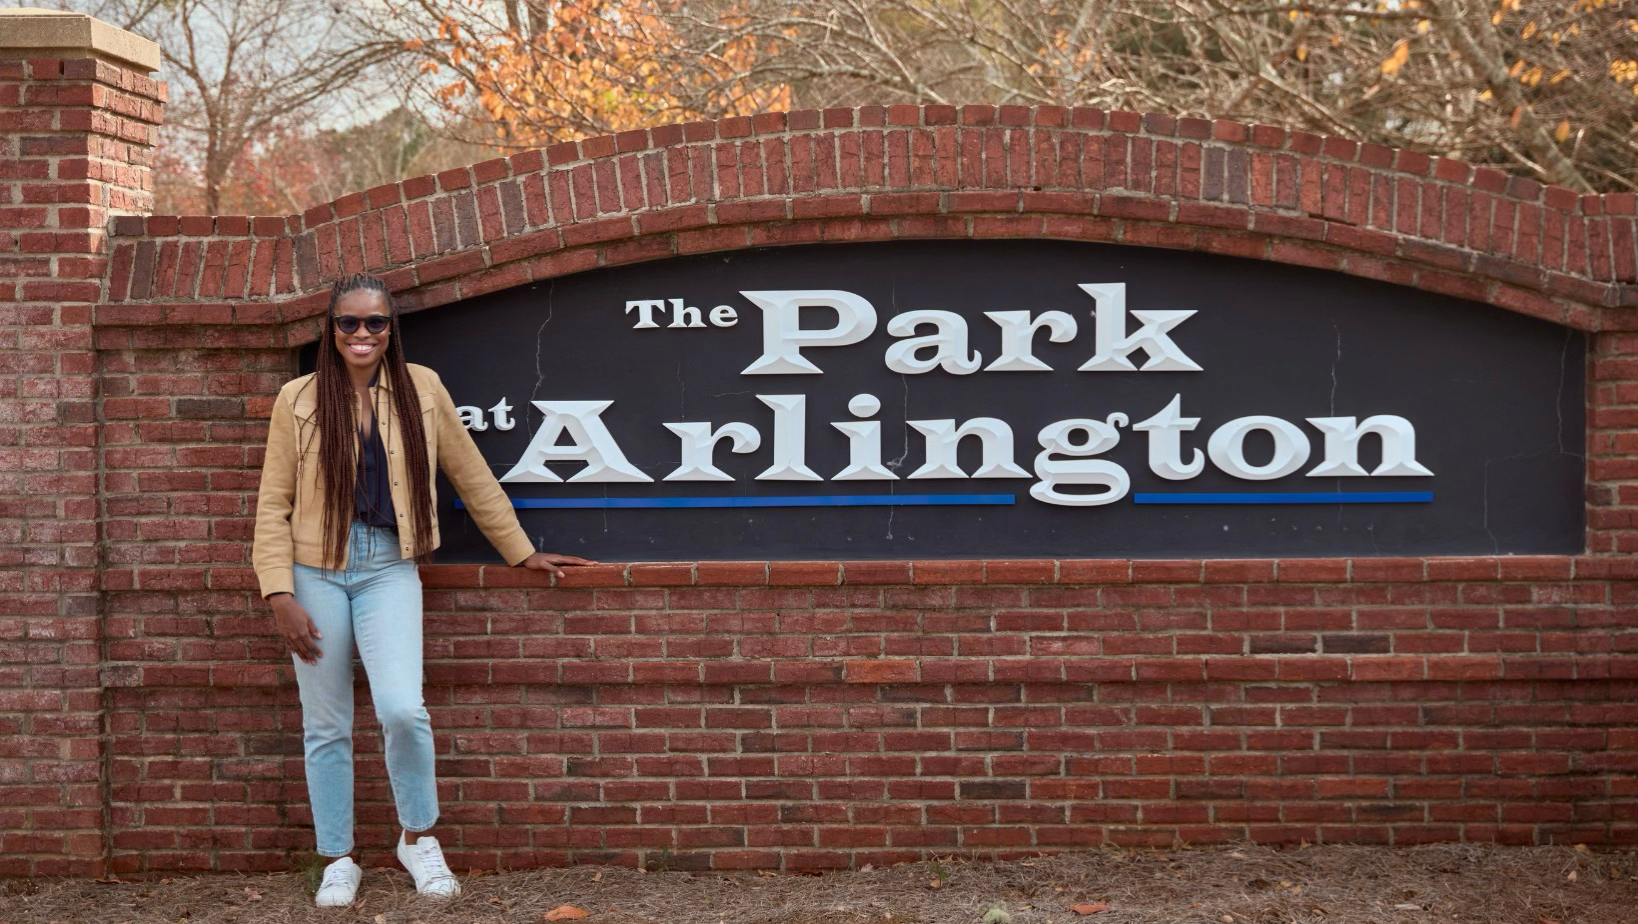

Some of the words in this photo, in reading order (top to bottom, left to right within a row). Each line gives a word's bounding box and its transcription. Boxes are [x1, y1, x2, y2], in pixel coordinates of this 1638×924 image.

[625, 298, 738, 329] The
[739, 282, 1204, 375] Park
[455, 396, 516, 432] at
[498, 392, 1435, 507] Arlington
